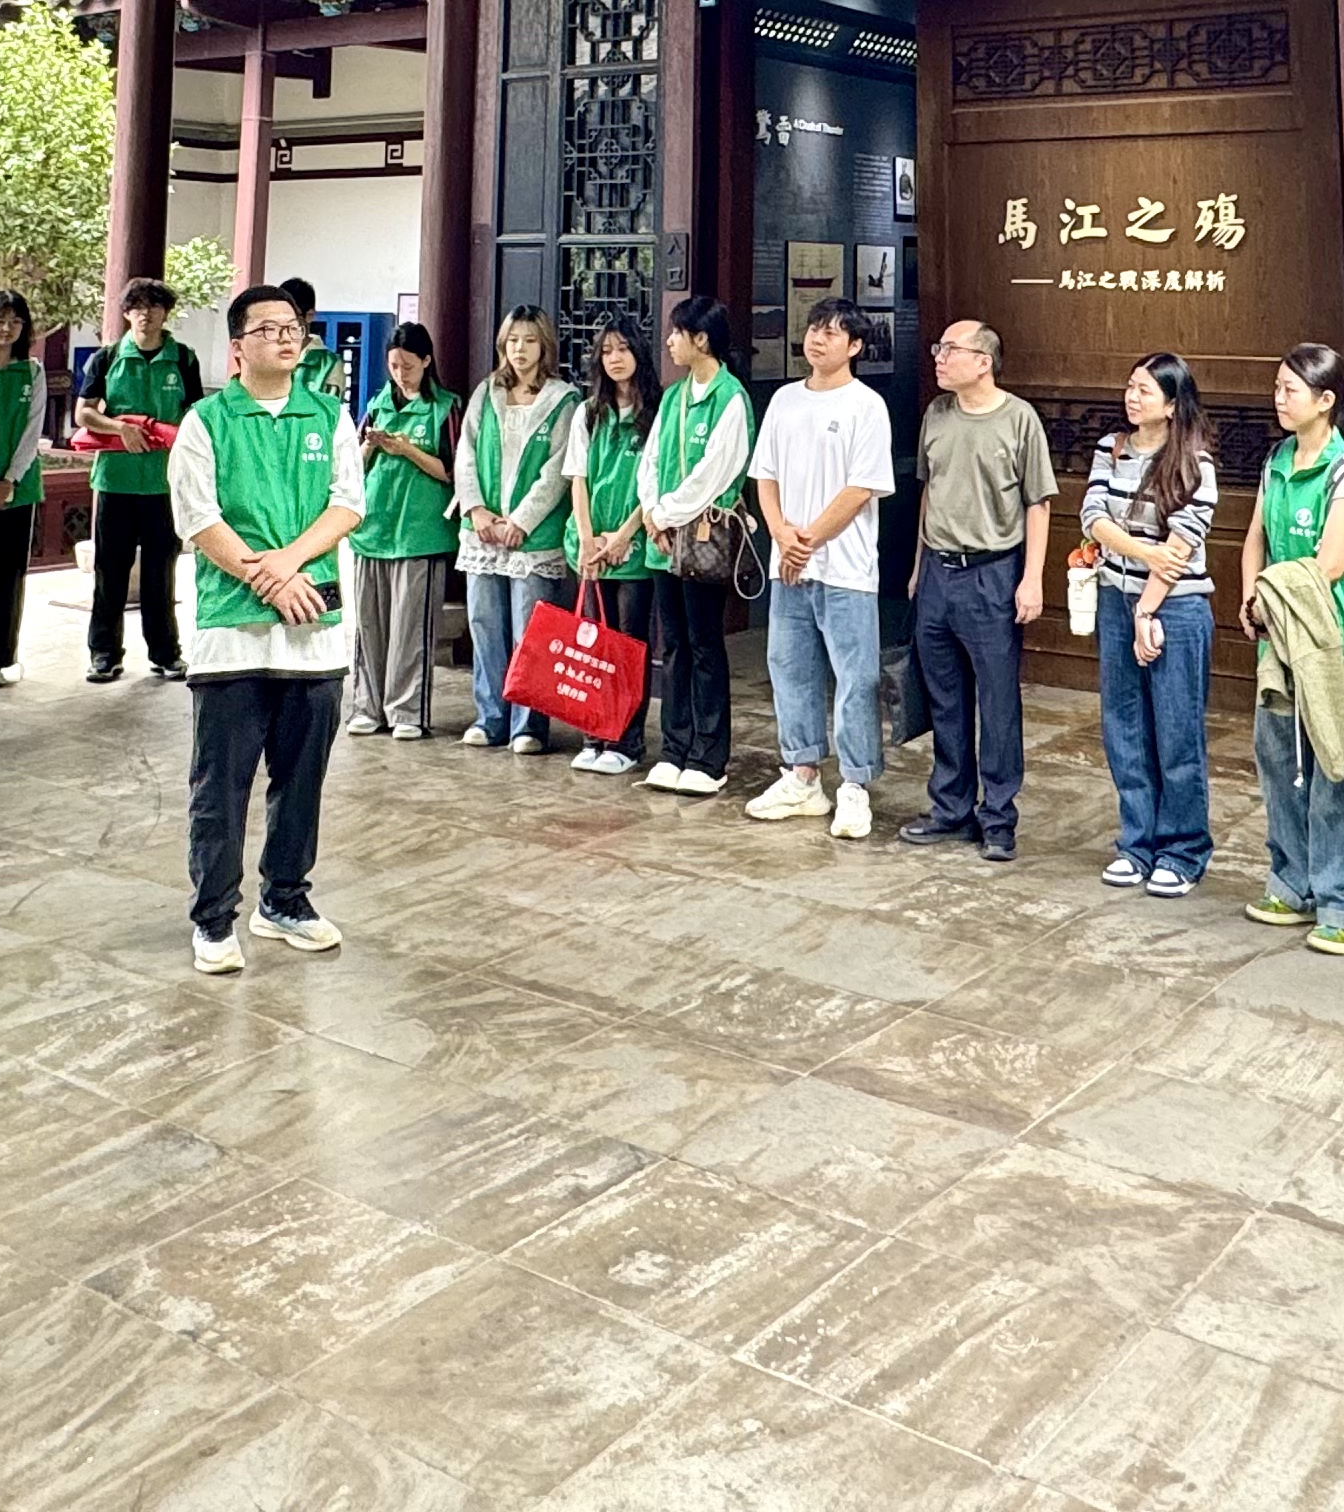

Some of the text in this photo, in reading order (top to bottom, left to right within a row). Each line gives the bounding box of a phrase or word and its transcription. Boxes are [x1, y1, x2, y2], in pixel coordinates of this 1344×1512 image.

[998, 192, 1246, 250] 馬江之殤
[667, 235, 685, 286] 入口
